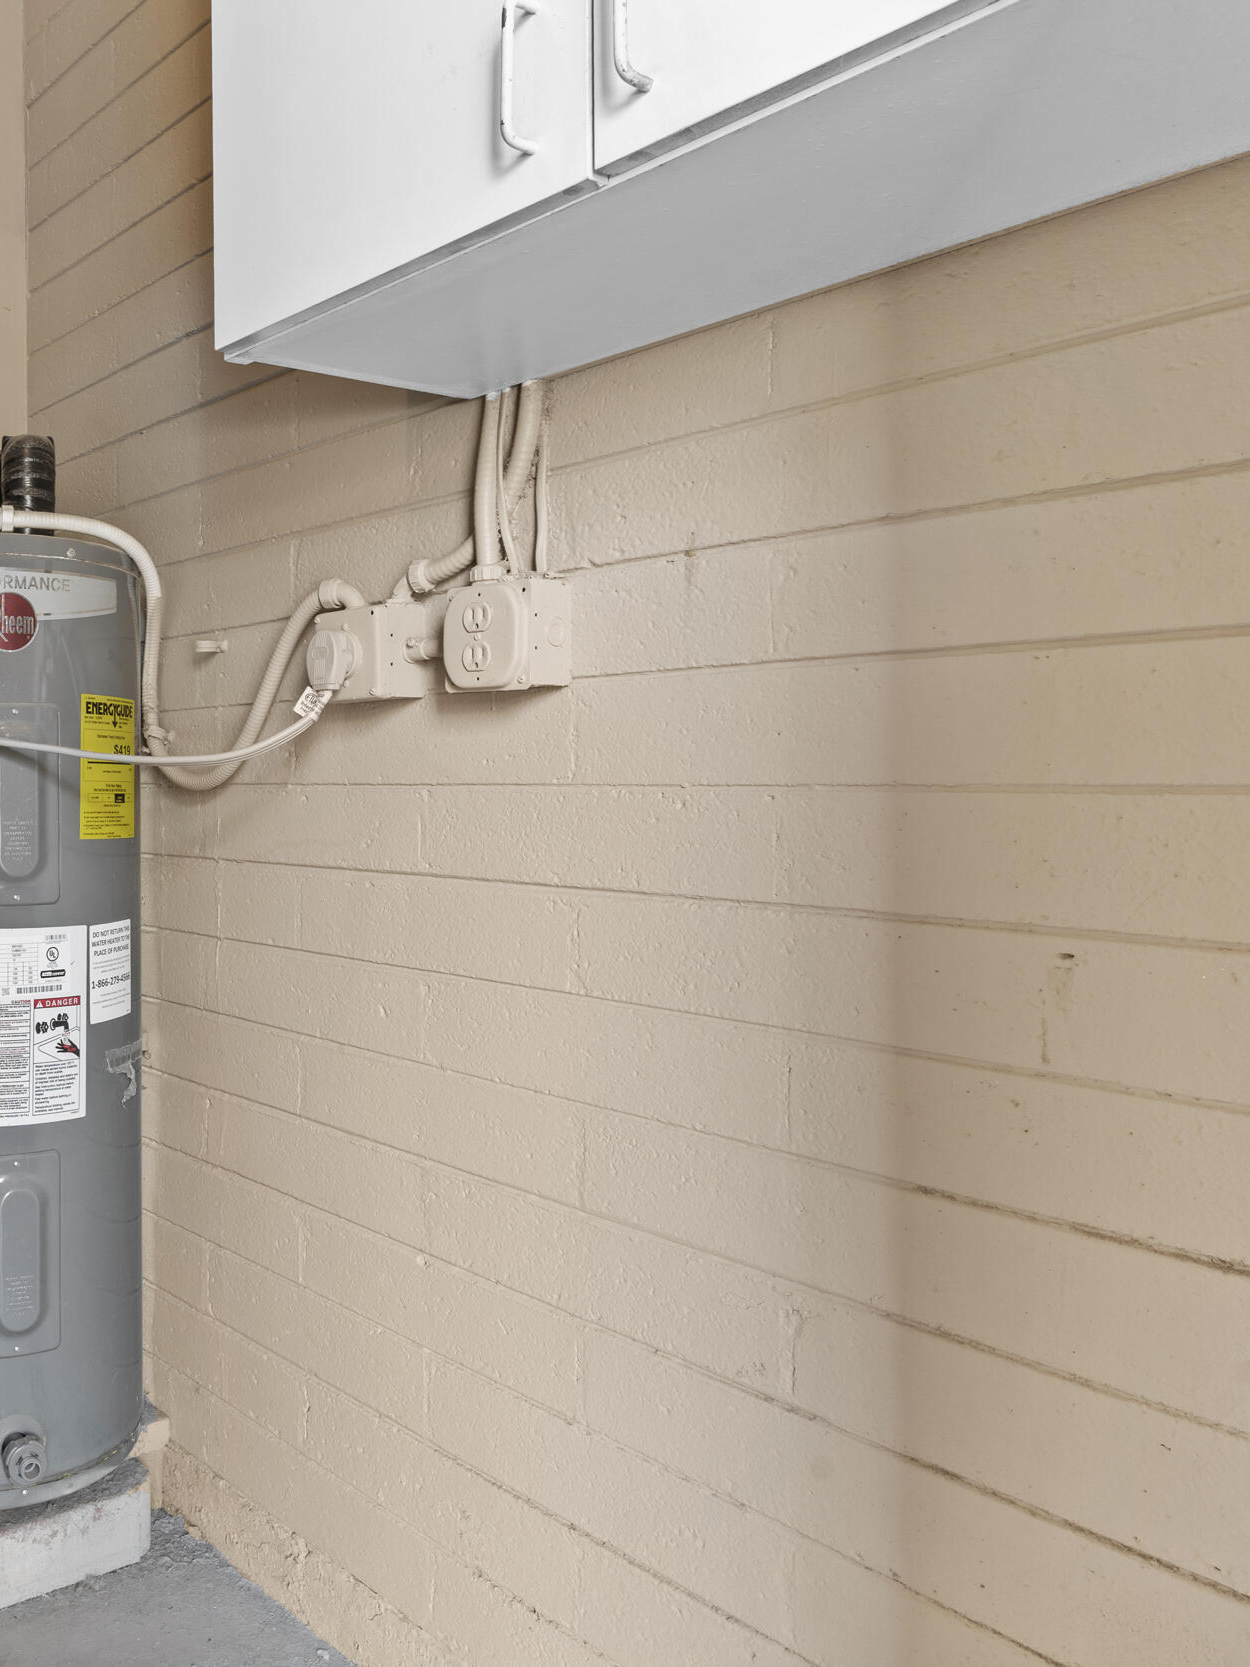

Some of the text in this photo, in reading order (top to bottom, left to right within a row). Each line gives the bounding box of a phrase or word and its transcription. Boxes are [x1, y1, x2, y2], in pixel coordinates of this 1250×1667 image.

[114, 744, 131, 755] $419
[94, 948, 107, 957] PLACE
[46, 998, 78, 1007] DANGER
